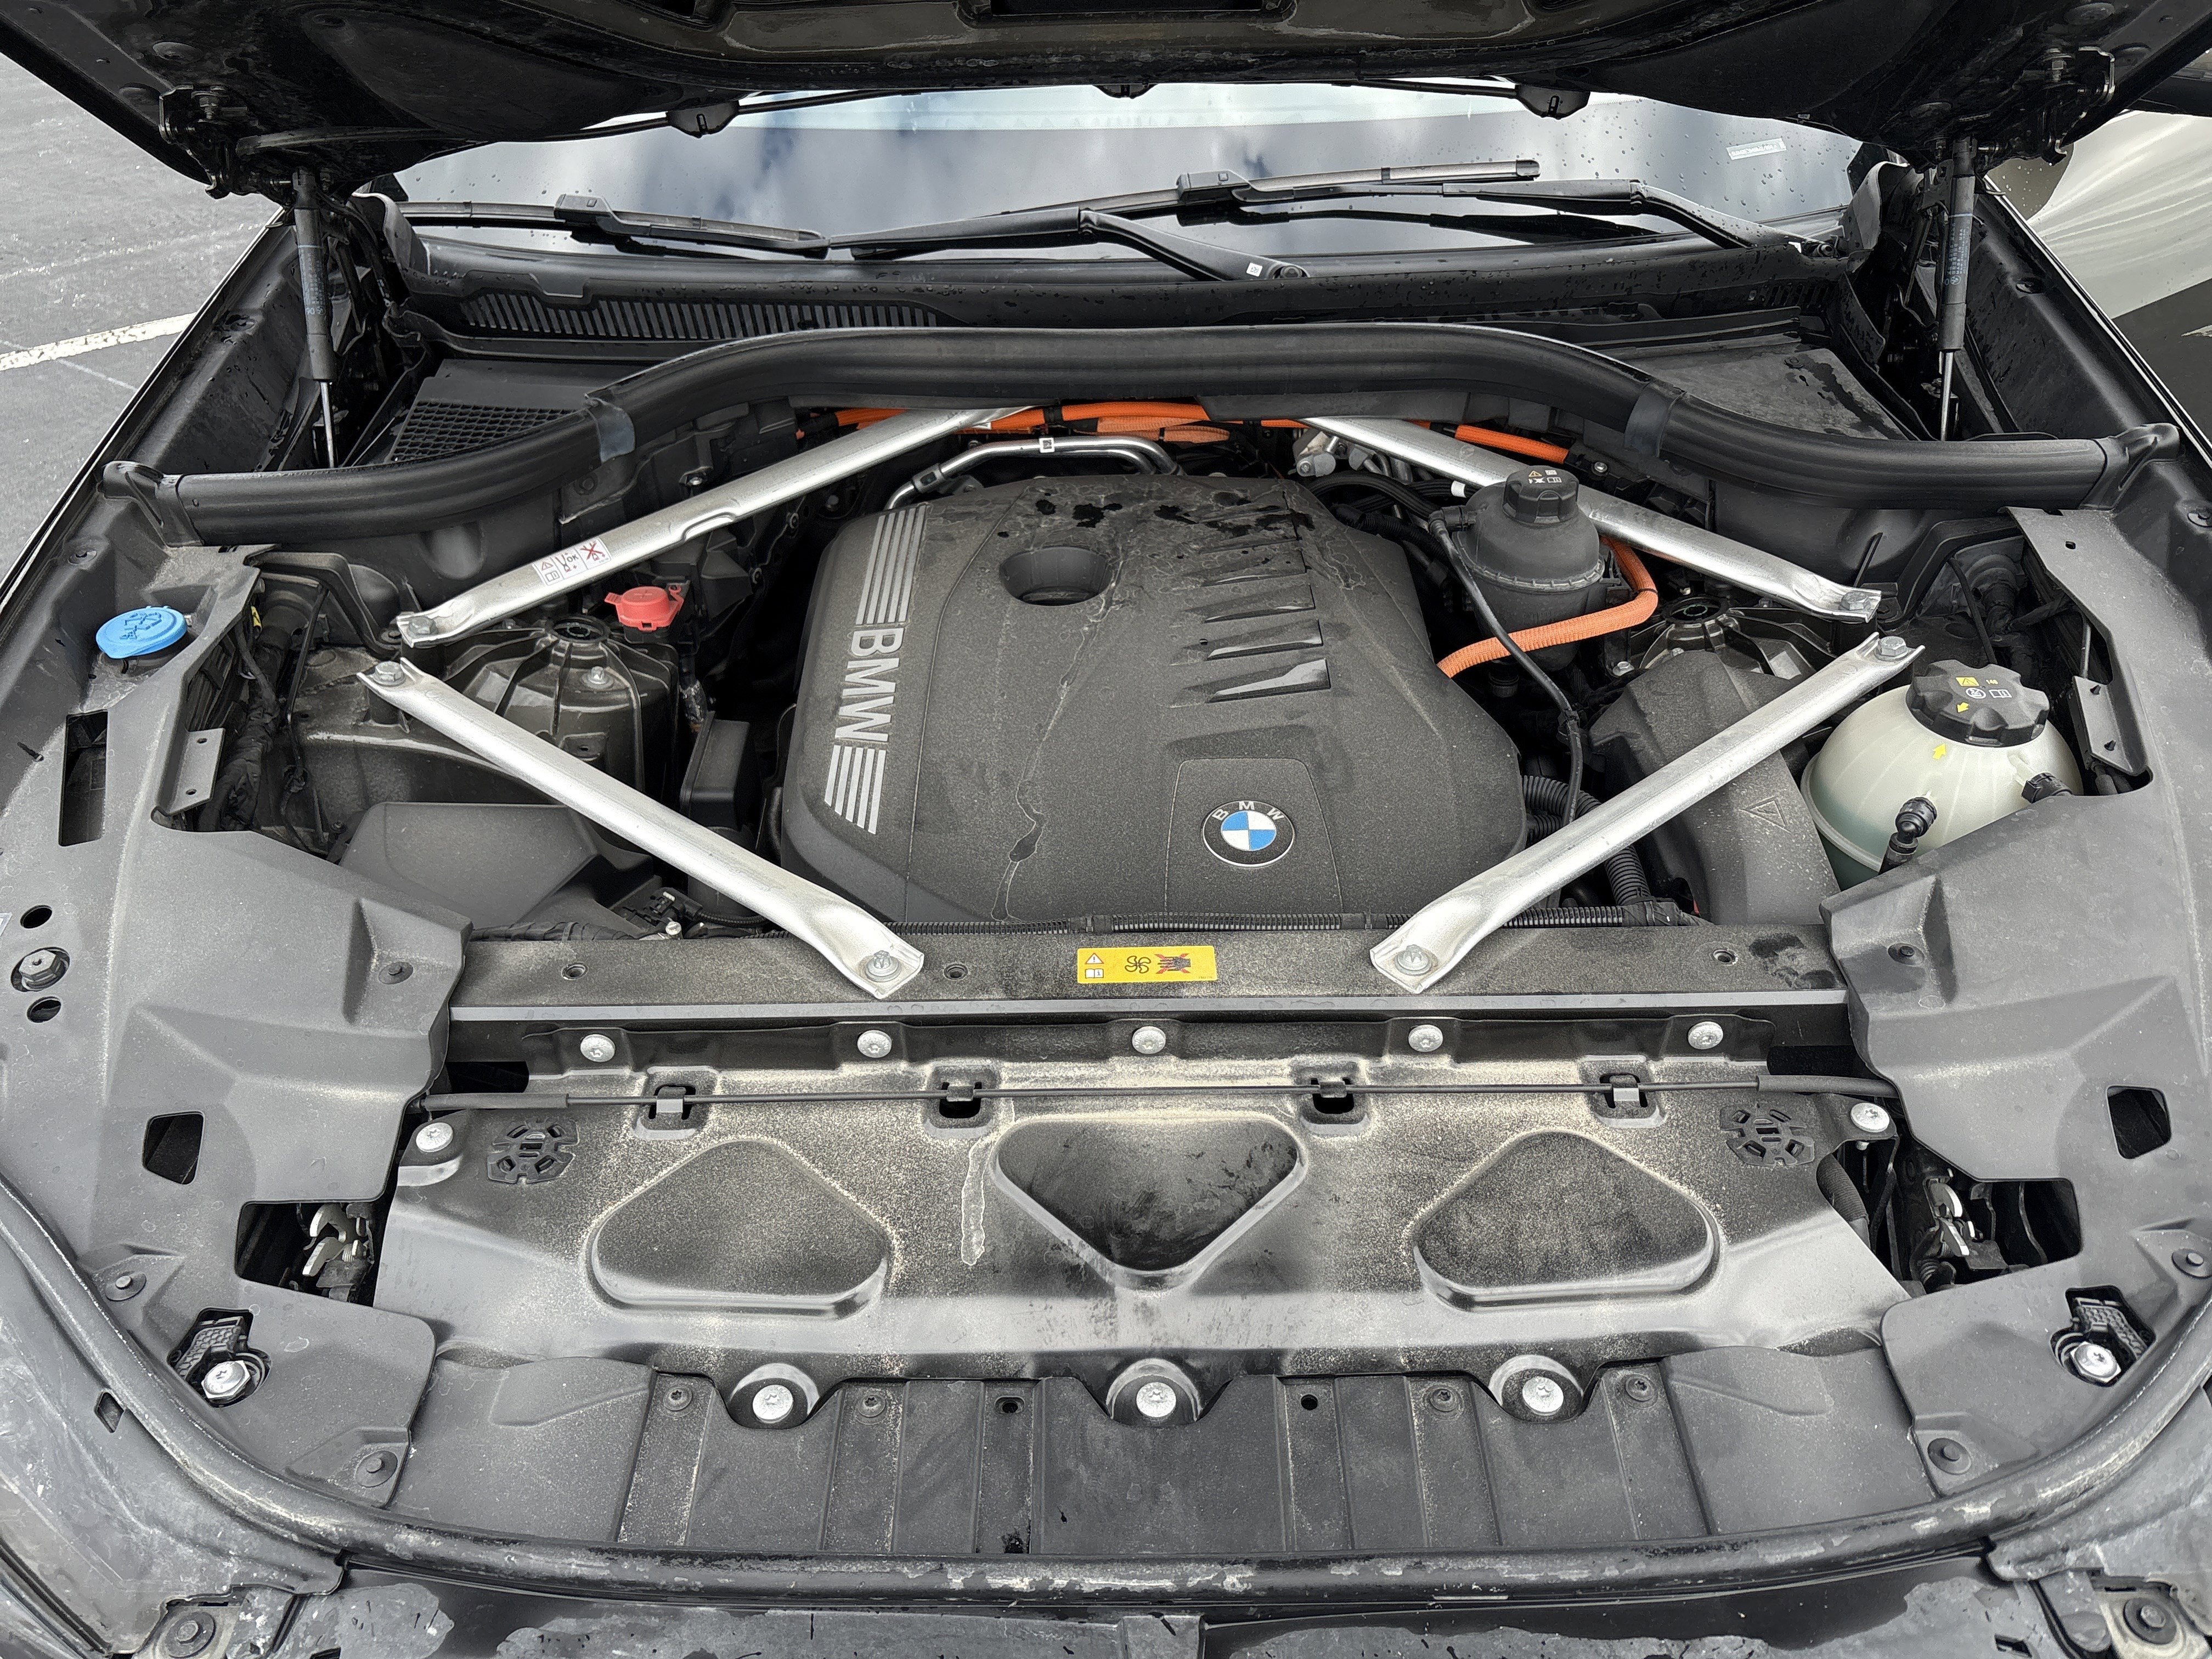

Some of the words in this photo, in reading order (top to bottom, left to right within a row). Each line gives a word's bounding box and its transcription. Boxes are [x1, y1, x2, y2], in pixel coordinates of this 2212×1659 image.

[567, 554, 579, 563] OK
[835, 627, 904, 742] BMW
[1211, 801, 1285, 821] BMW
